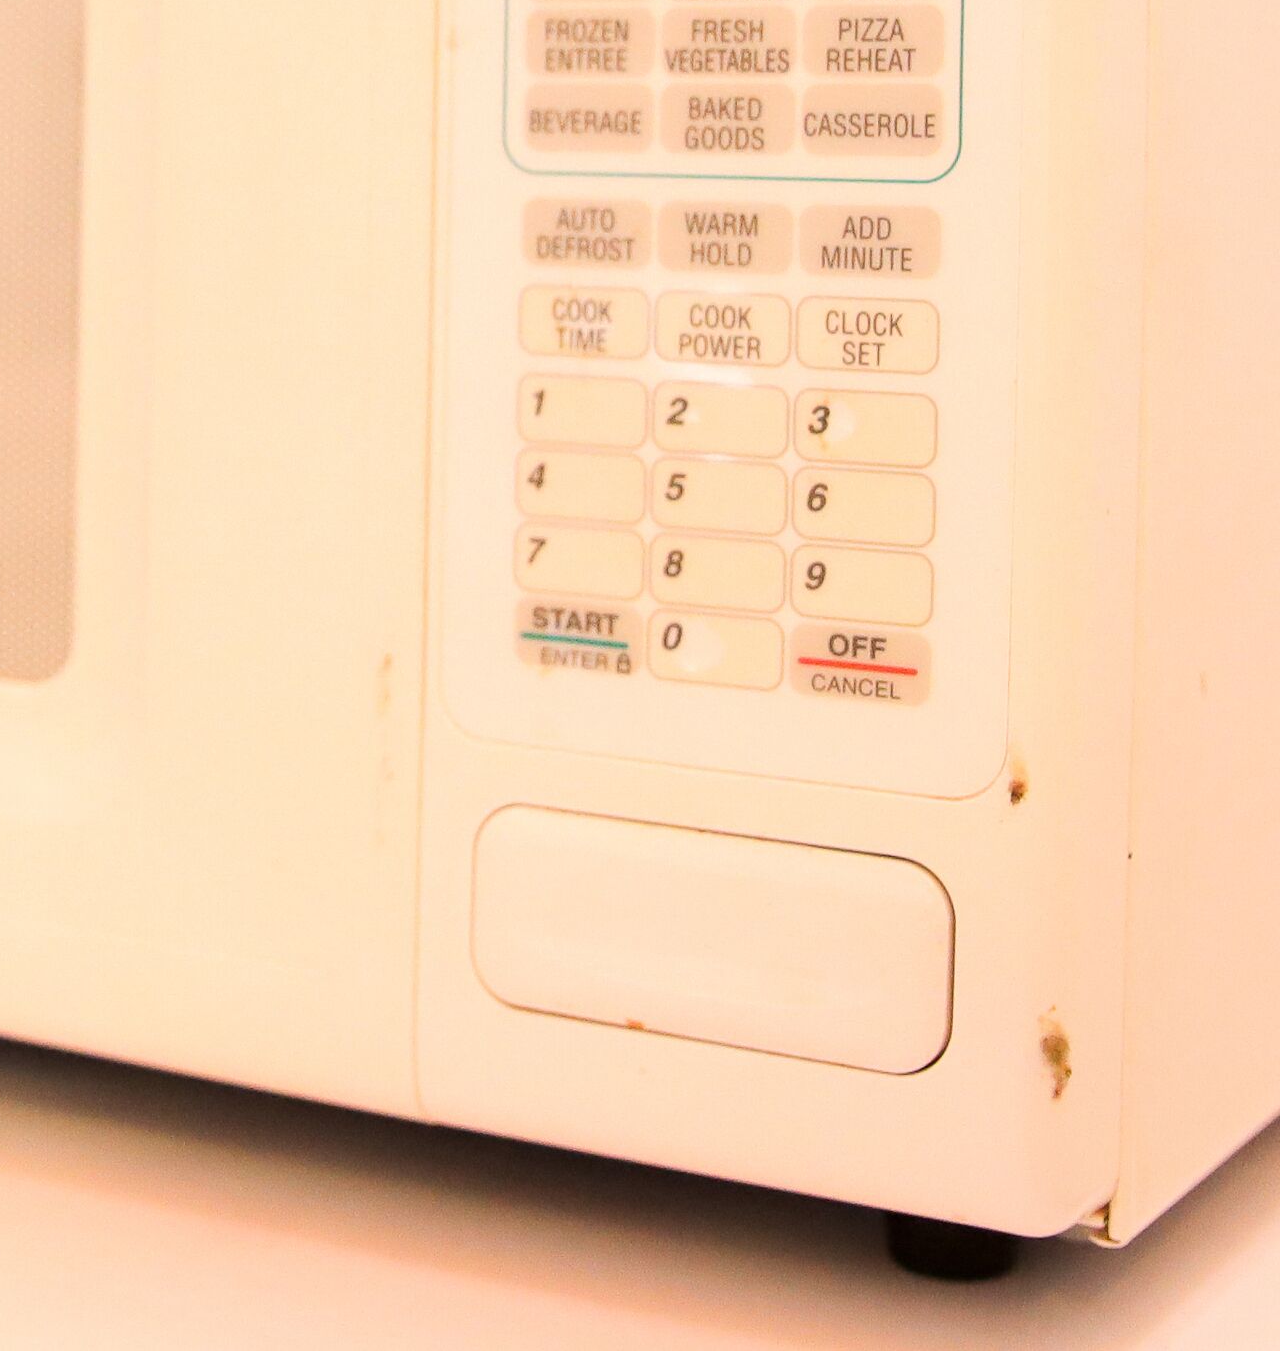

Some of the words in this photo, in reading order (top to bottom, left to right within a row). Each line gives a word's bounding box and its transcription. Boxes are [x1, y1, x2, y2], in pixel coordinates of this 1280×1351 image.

[545, 19, 630, 42] FROZEN
[692, 20, 764, 42] FRESH
[839, 18, 904, 42] PIZZA
[545, 49, 627, 71] ENTREE
[665, 50, 790, 73] VEGETABLES
[827, 49, 916, 72] REHEAT
[688, 97, 762, 120] BAKED
[530, 111, 641, 134] BEVERAGE
[804, 114, 936, 138] CASSEROLE
[685, 127, 764, 150] GOODS
[556, 208, 615, 232] AUTO
[685, 213, 758, 236] WARM
[842, 216, 892, 239] ADD
[536, 236, 635, 262] DEFROST
[690, 244, 752, 267] HOLD
[821, 247, 913, 272] MINUTE
[552, 298, 612, 322] COOK
[689, 305, 752, 330] COOK
[826, 311, 903, 337] CLOCK
[557, 327, 607, 352] TIME
[679, 334, 761, 359] POWER
[842, 343, 885, 366] SET
[533, 389, 545, 415] 1
[666, 398, 689, 425] 2
[808, 406, 830, 434] 3
[527, 463, 546, 489] 4
[665, 474, 687, 501] 5
[807, 483, 829, 511] 6
[527, 538, 546, 564] 7
[663, 550, 684, 577] 8
[805, 562, 826, 590] 9
[533, 607, 619, 635] START
[663, 624, 683, 650] 0
[828, 634, 887, 659] OFF
[540, 647, 609, 671] ENTER
[811, 673, 901, 699] CANCEL
